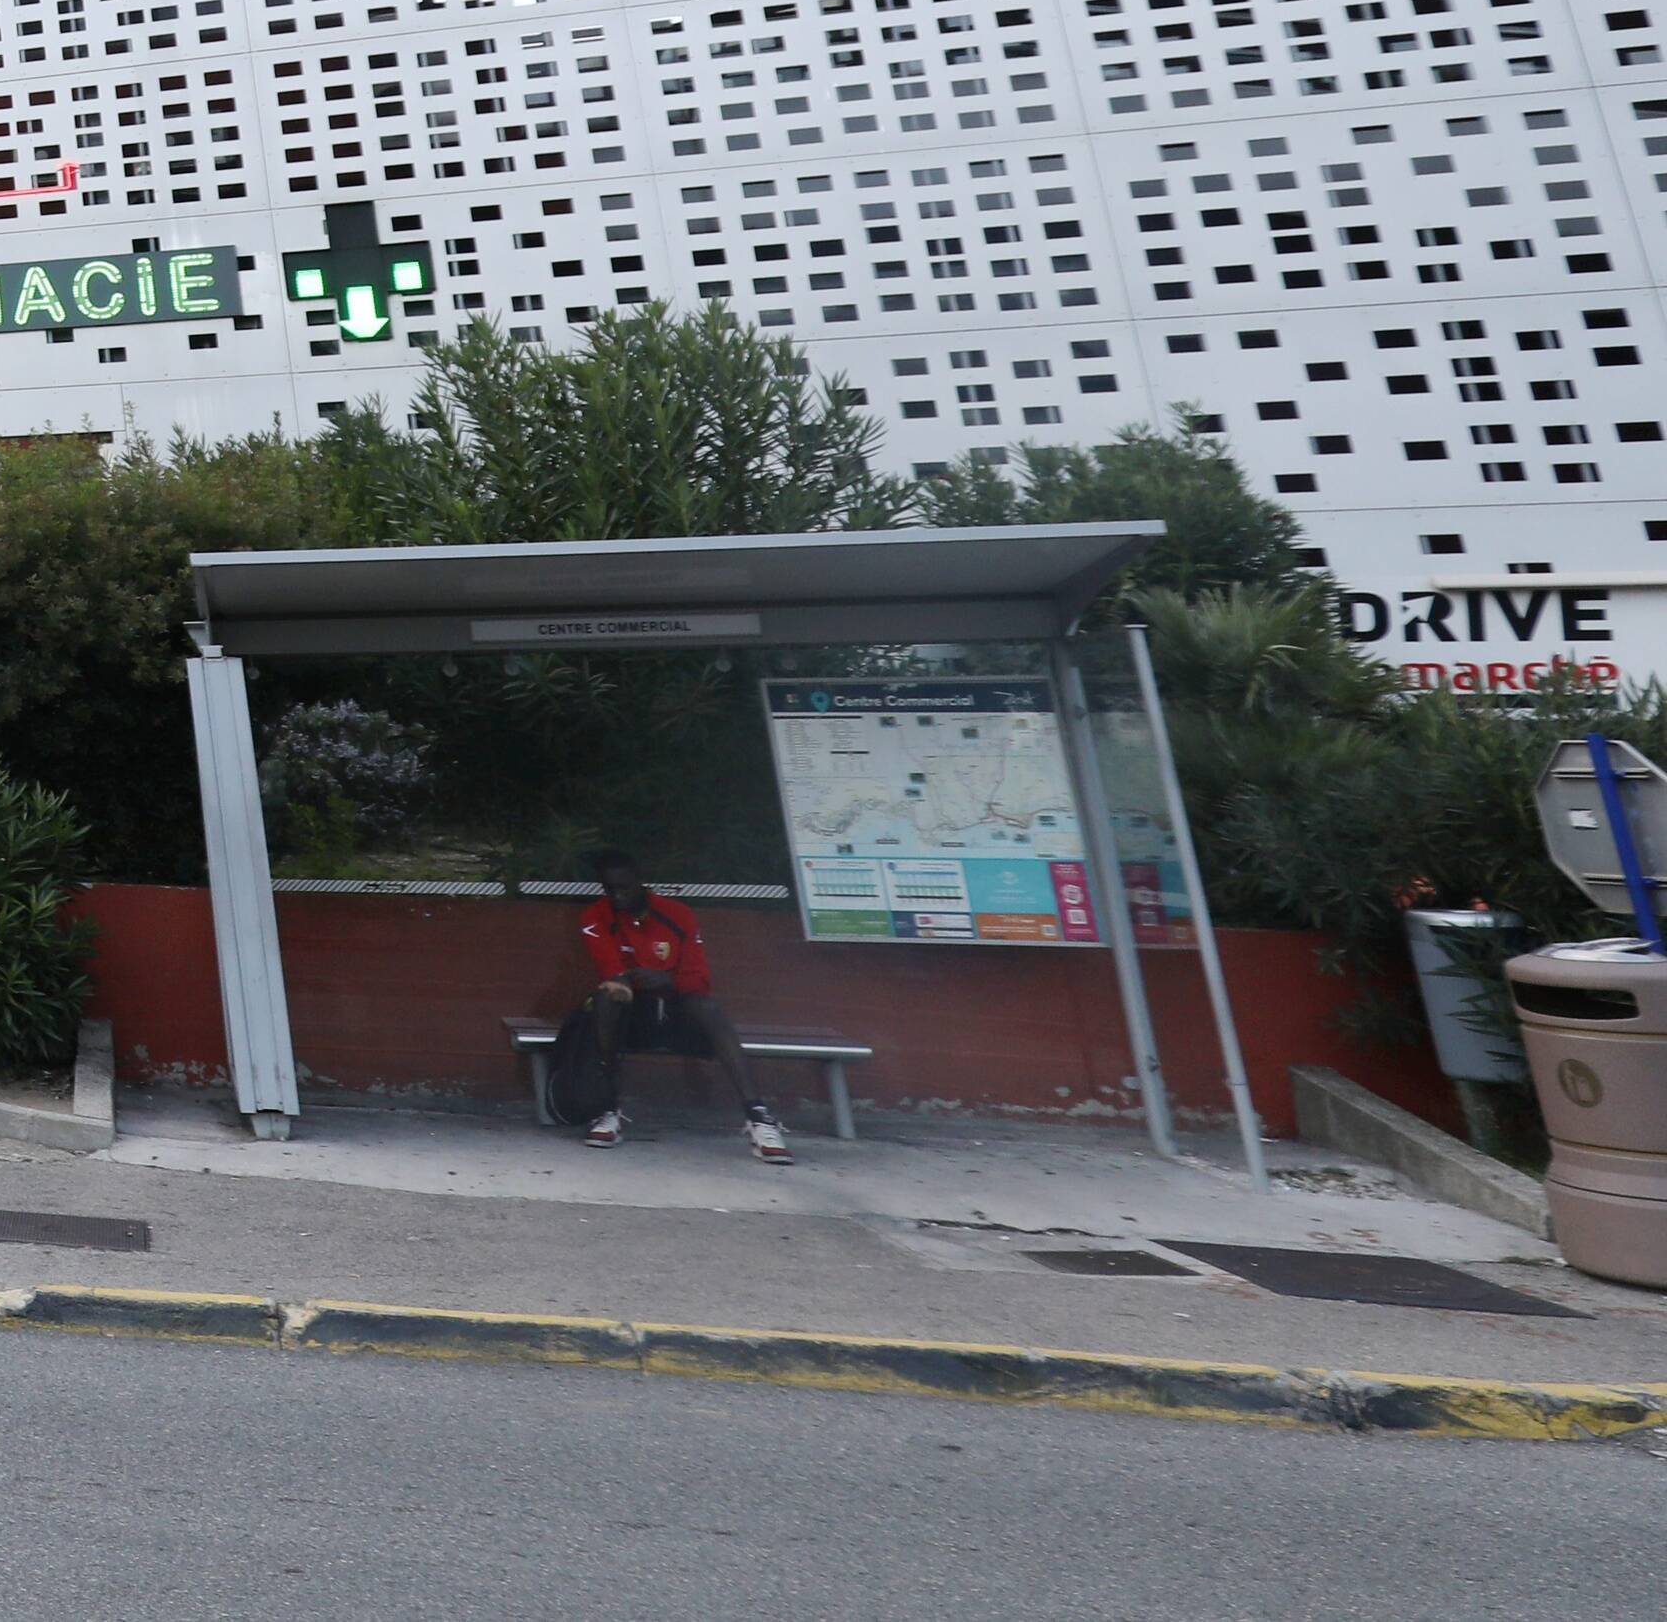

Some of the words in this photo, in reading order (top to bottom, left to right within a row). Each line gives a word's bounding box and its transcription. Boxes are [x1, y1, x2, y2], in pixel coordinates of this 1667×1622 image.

[1339, 588, 1613, 643] DRIVE
[538, 622, 592, 635] CENTRE
[597, 620, 691, 634] COMMERCIAL
[833, 695, 882, 708] Centre
[886, 692, 975, 708] Commercial
